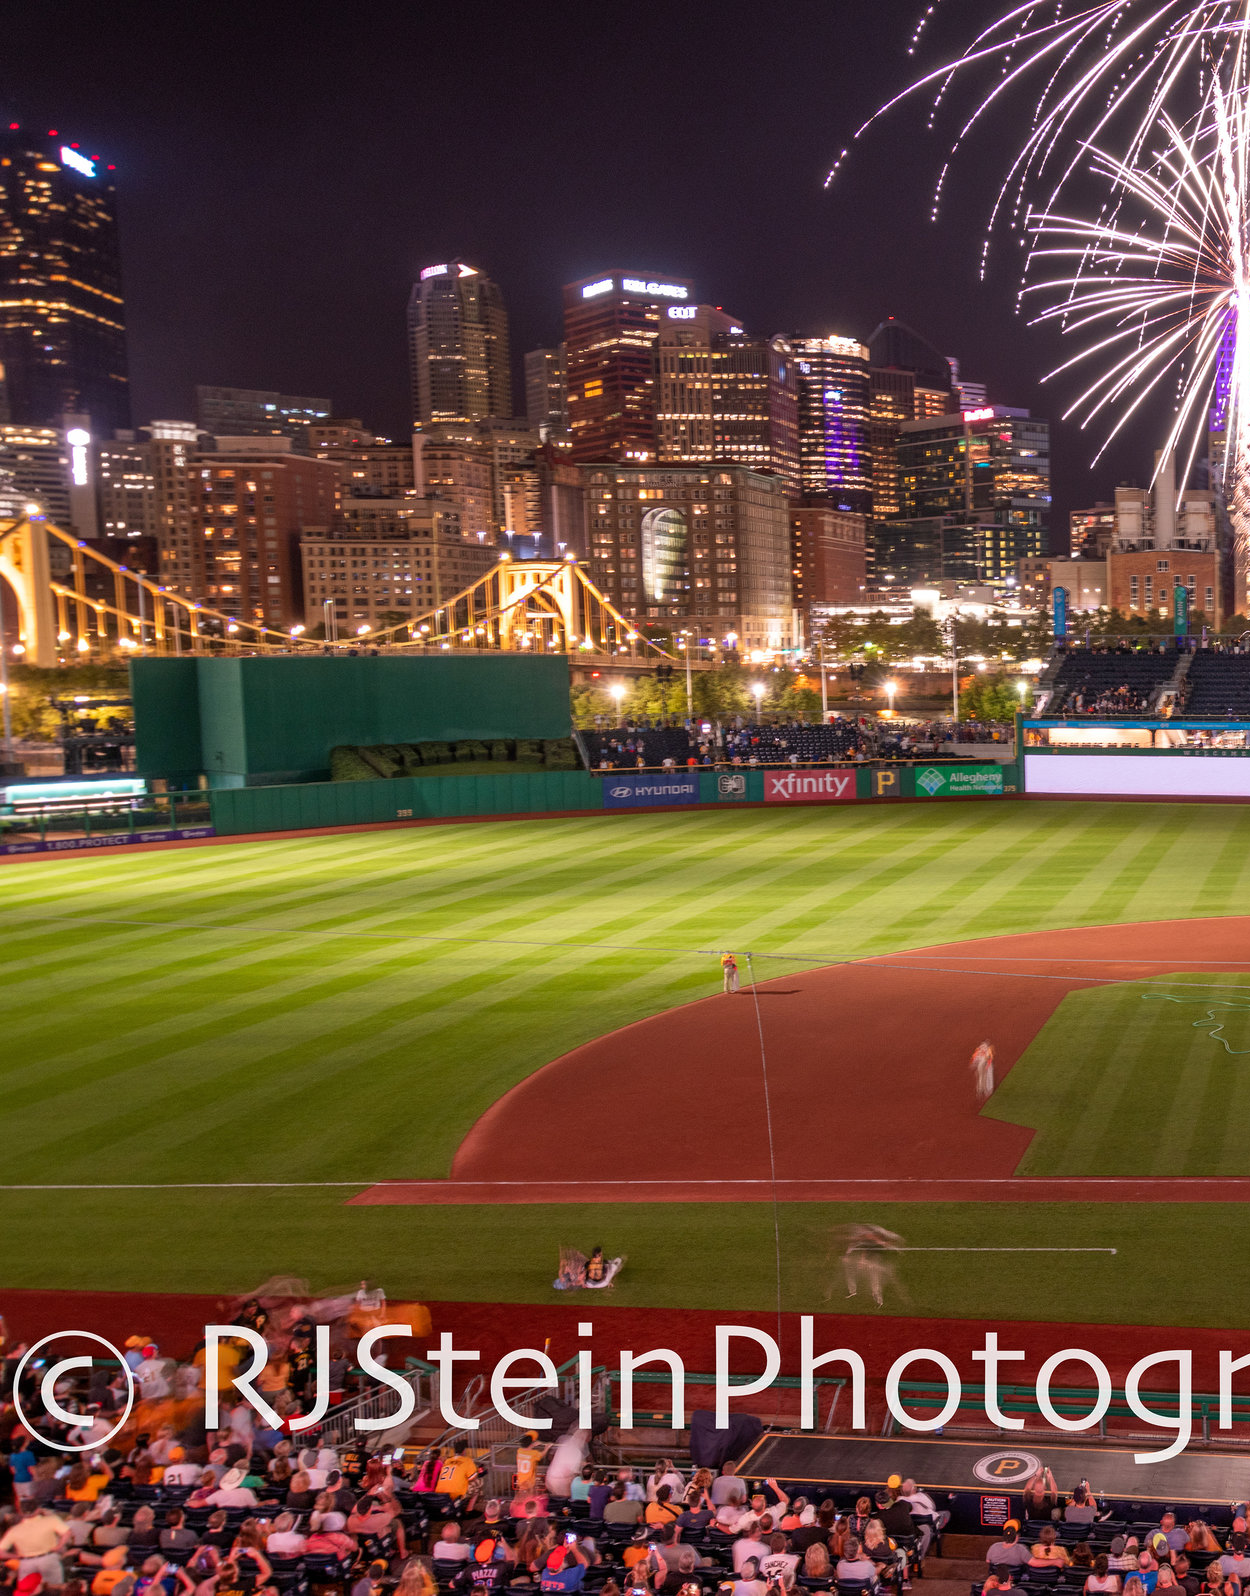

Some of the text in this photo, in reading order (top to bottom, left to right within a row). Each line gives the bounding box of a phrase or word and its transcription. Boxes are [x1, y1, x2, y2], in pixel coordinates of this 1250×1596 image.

[950, 772, 1001, 783] Allegheny
[635, 784, 695, 797] HYUNDAI
[771, 773, 849, 798] xfinity
[973, 783, 1003, 792] Network
[440, 1465, 455, 1480] 21
[167, 1473, 182, 1485] 21
[764, 1560, 789, 1570] SANCHEZ
[472, 1567, 498, 1580] PIAZZA
